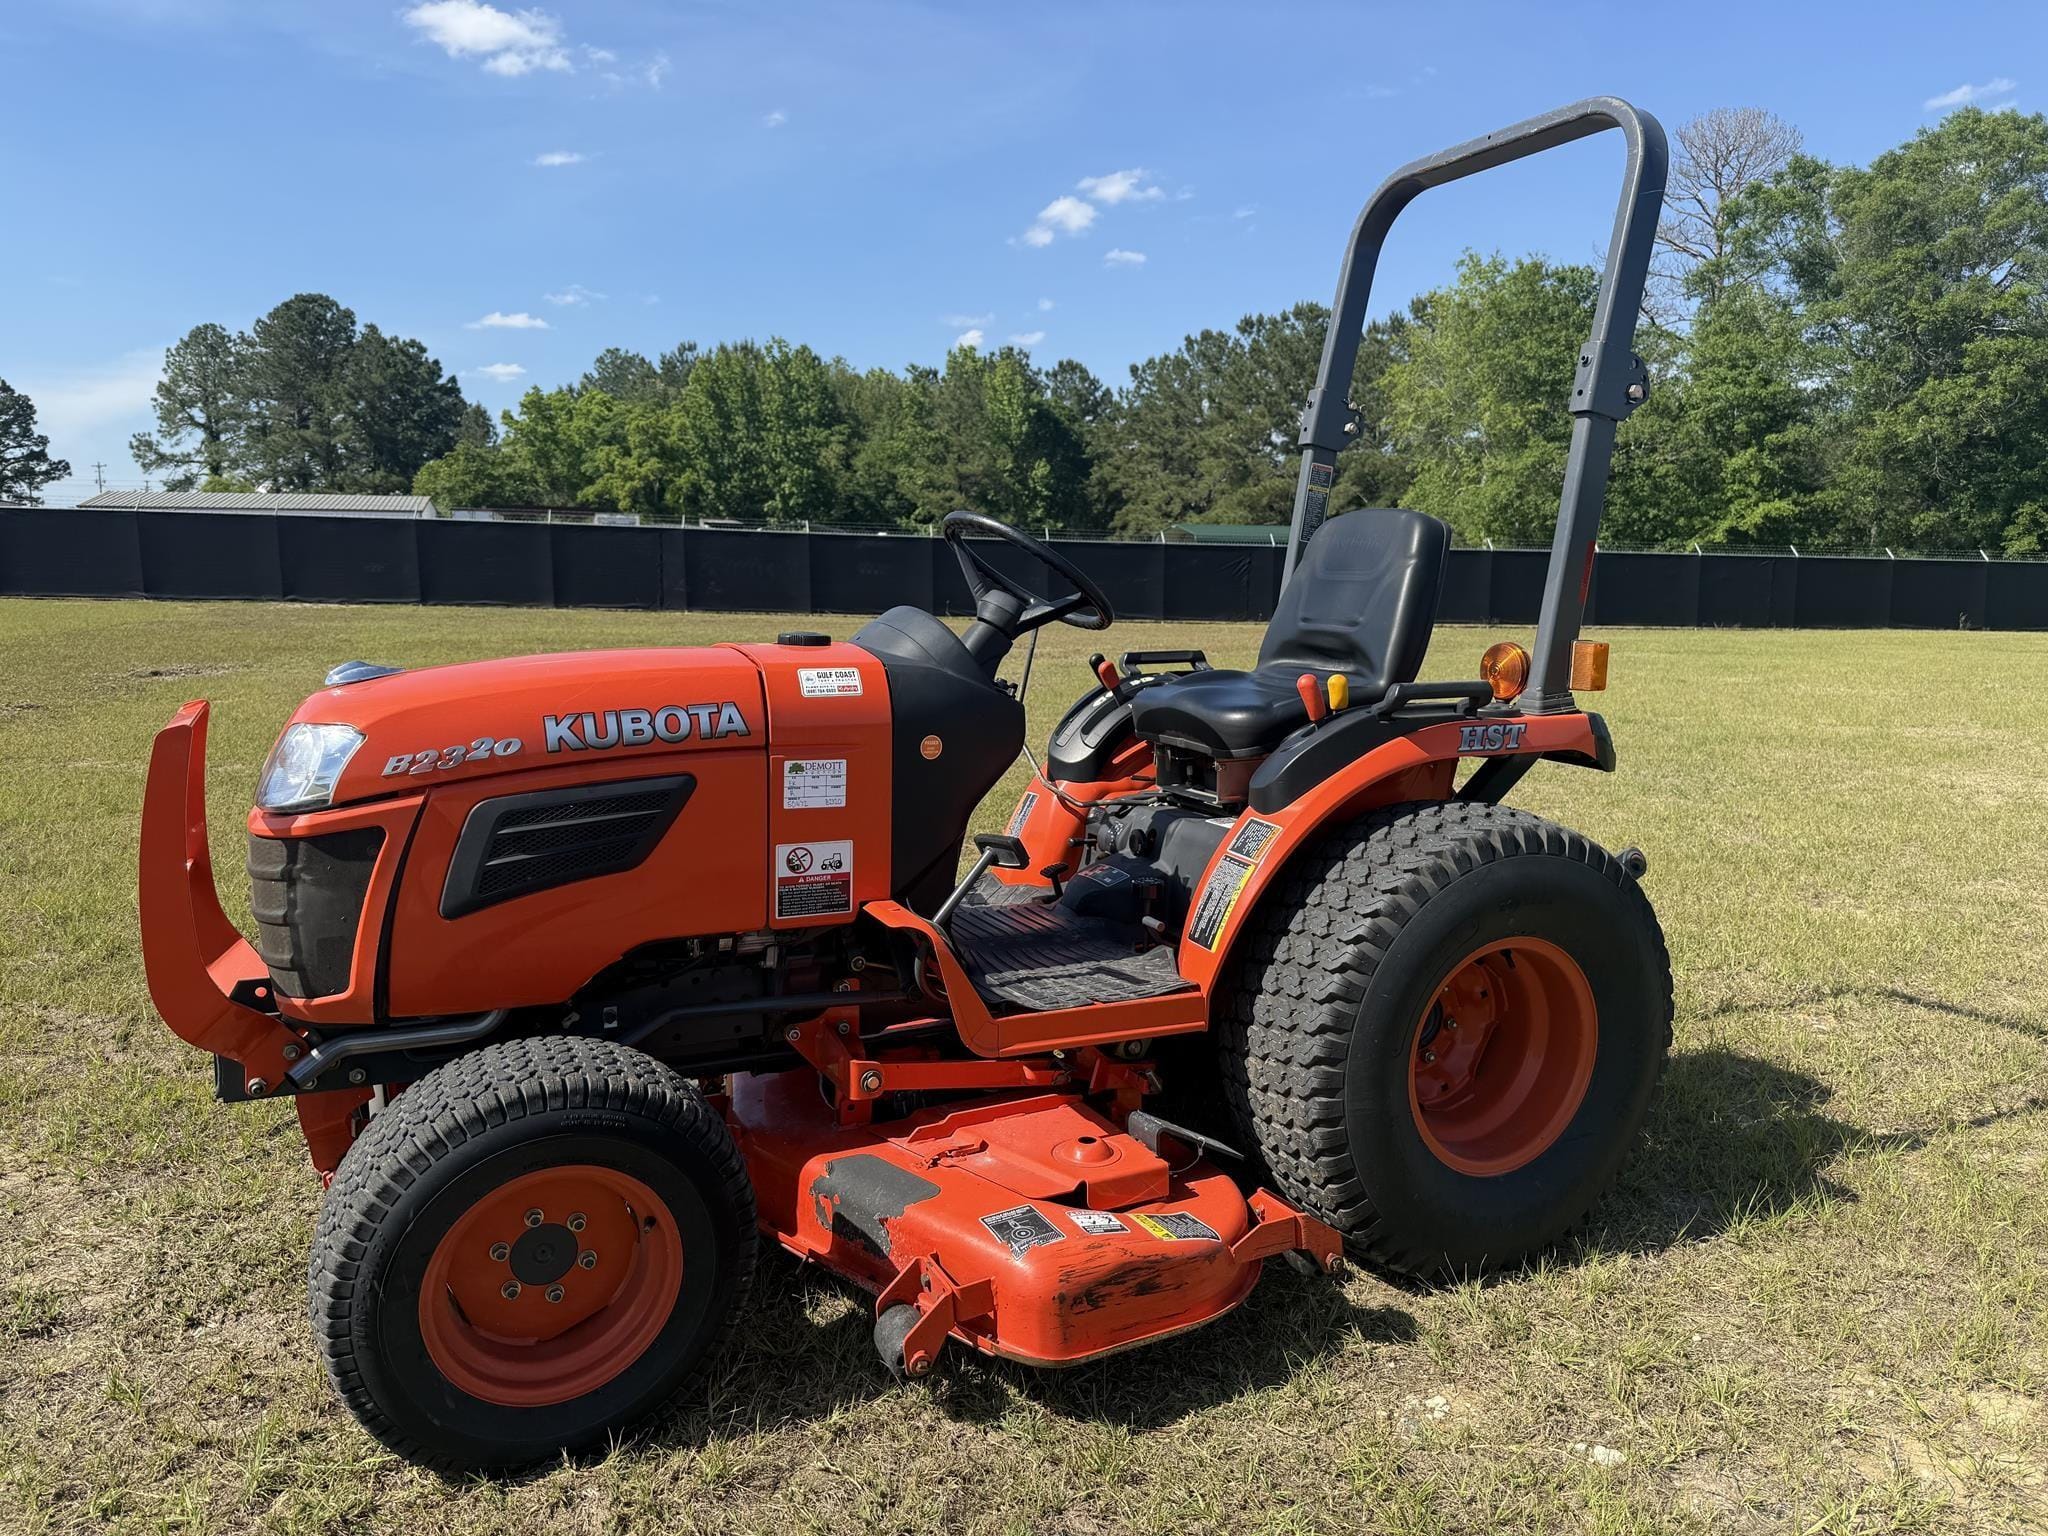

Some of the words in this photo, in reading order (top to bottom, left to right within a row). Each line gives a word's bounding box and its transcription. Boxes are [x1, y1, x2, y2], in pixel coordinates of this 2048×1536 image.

[816, 671, 833, 679] GULF
[834, 670, 856, 678] COAST
[543, 702, 750, 753] KUBOTA
[1457, 723, 1527, 752] HST
[381, 736, 522, 777] B2320
[805, 761, 843, 771] DEMOTT
[806, 874, 832, 882] DANGER
